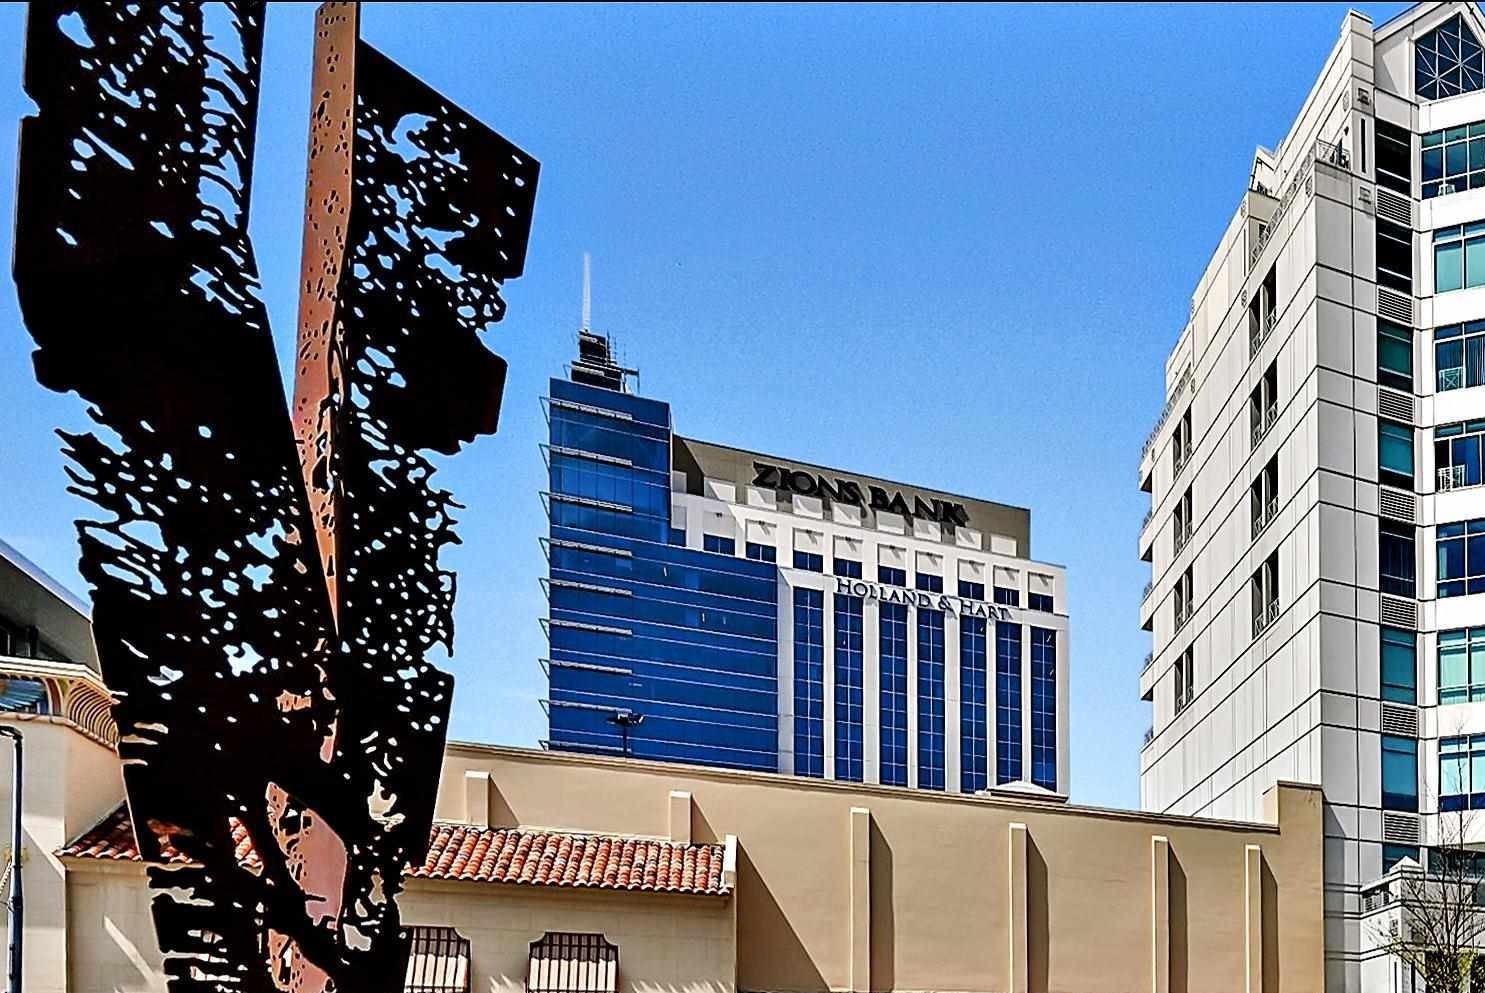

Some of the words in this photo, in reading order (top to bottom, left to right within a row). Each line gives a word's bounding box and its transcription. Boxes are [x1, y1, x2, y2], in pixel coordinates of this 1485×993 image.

[752, 461, 866, 508] ZIONS
[868, 485, 970, 528] BANK
[836, 577, 932, 608] HOLLAND
[959, 599, 1011, 620] HART
